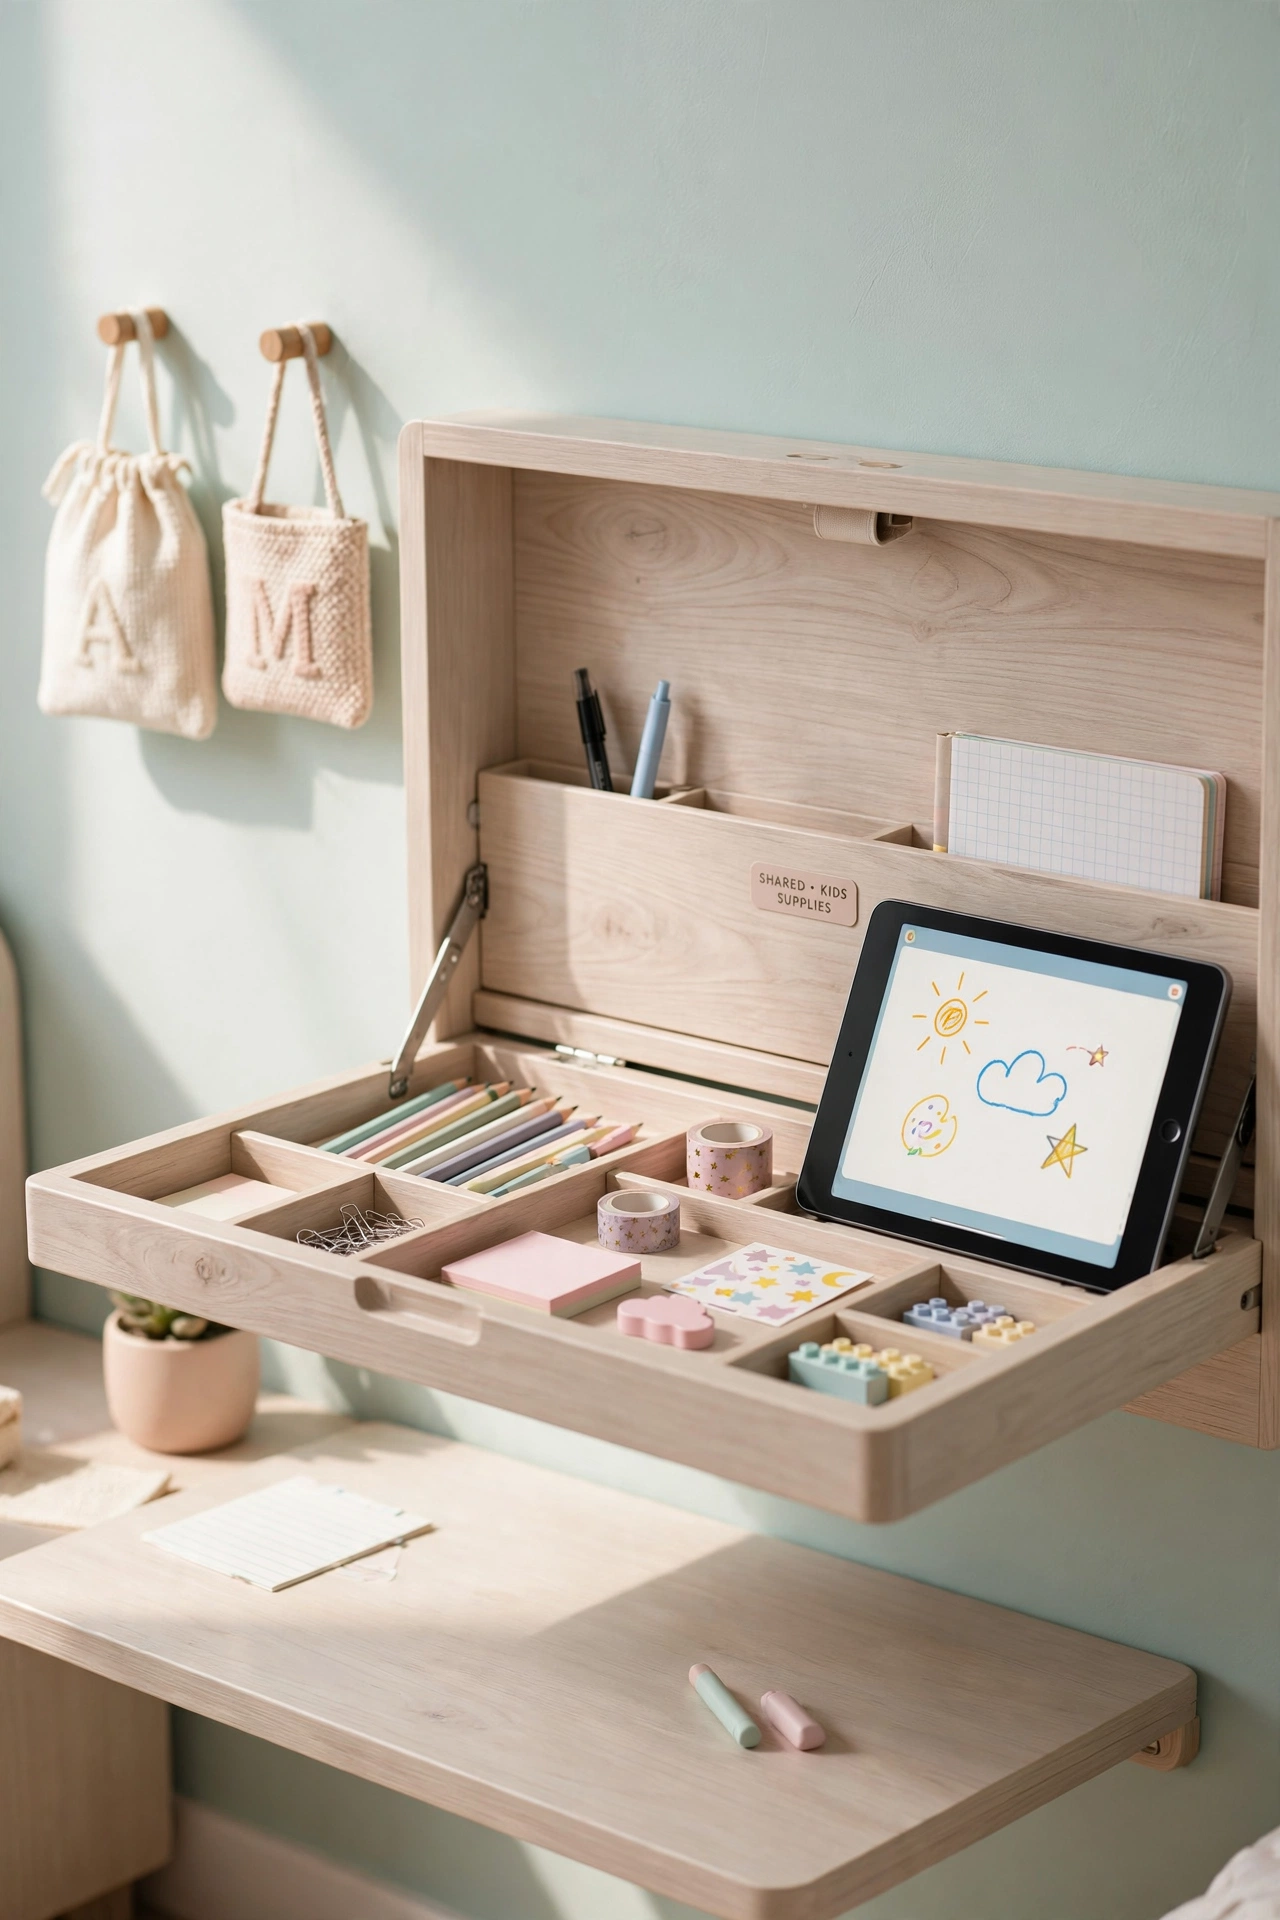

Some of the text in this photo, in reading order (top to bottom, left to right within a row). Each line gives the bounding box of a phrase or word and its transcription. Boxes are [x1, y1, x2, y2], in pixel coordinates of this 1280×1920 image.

[77, 579, 143, 675] A
[247, 578, 323, 680] M
[759, 872, 847, 900] SHARED KIDS
[777, 892, 831, 914] SUPPLIES
